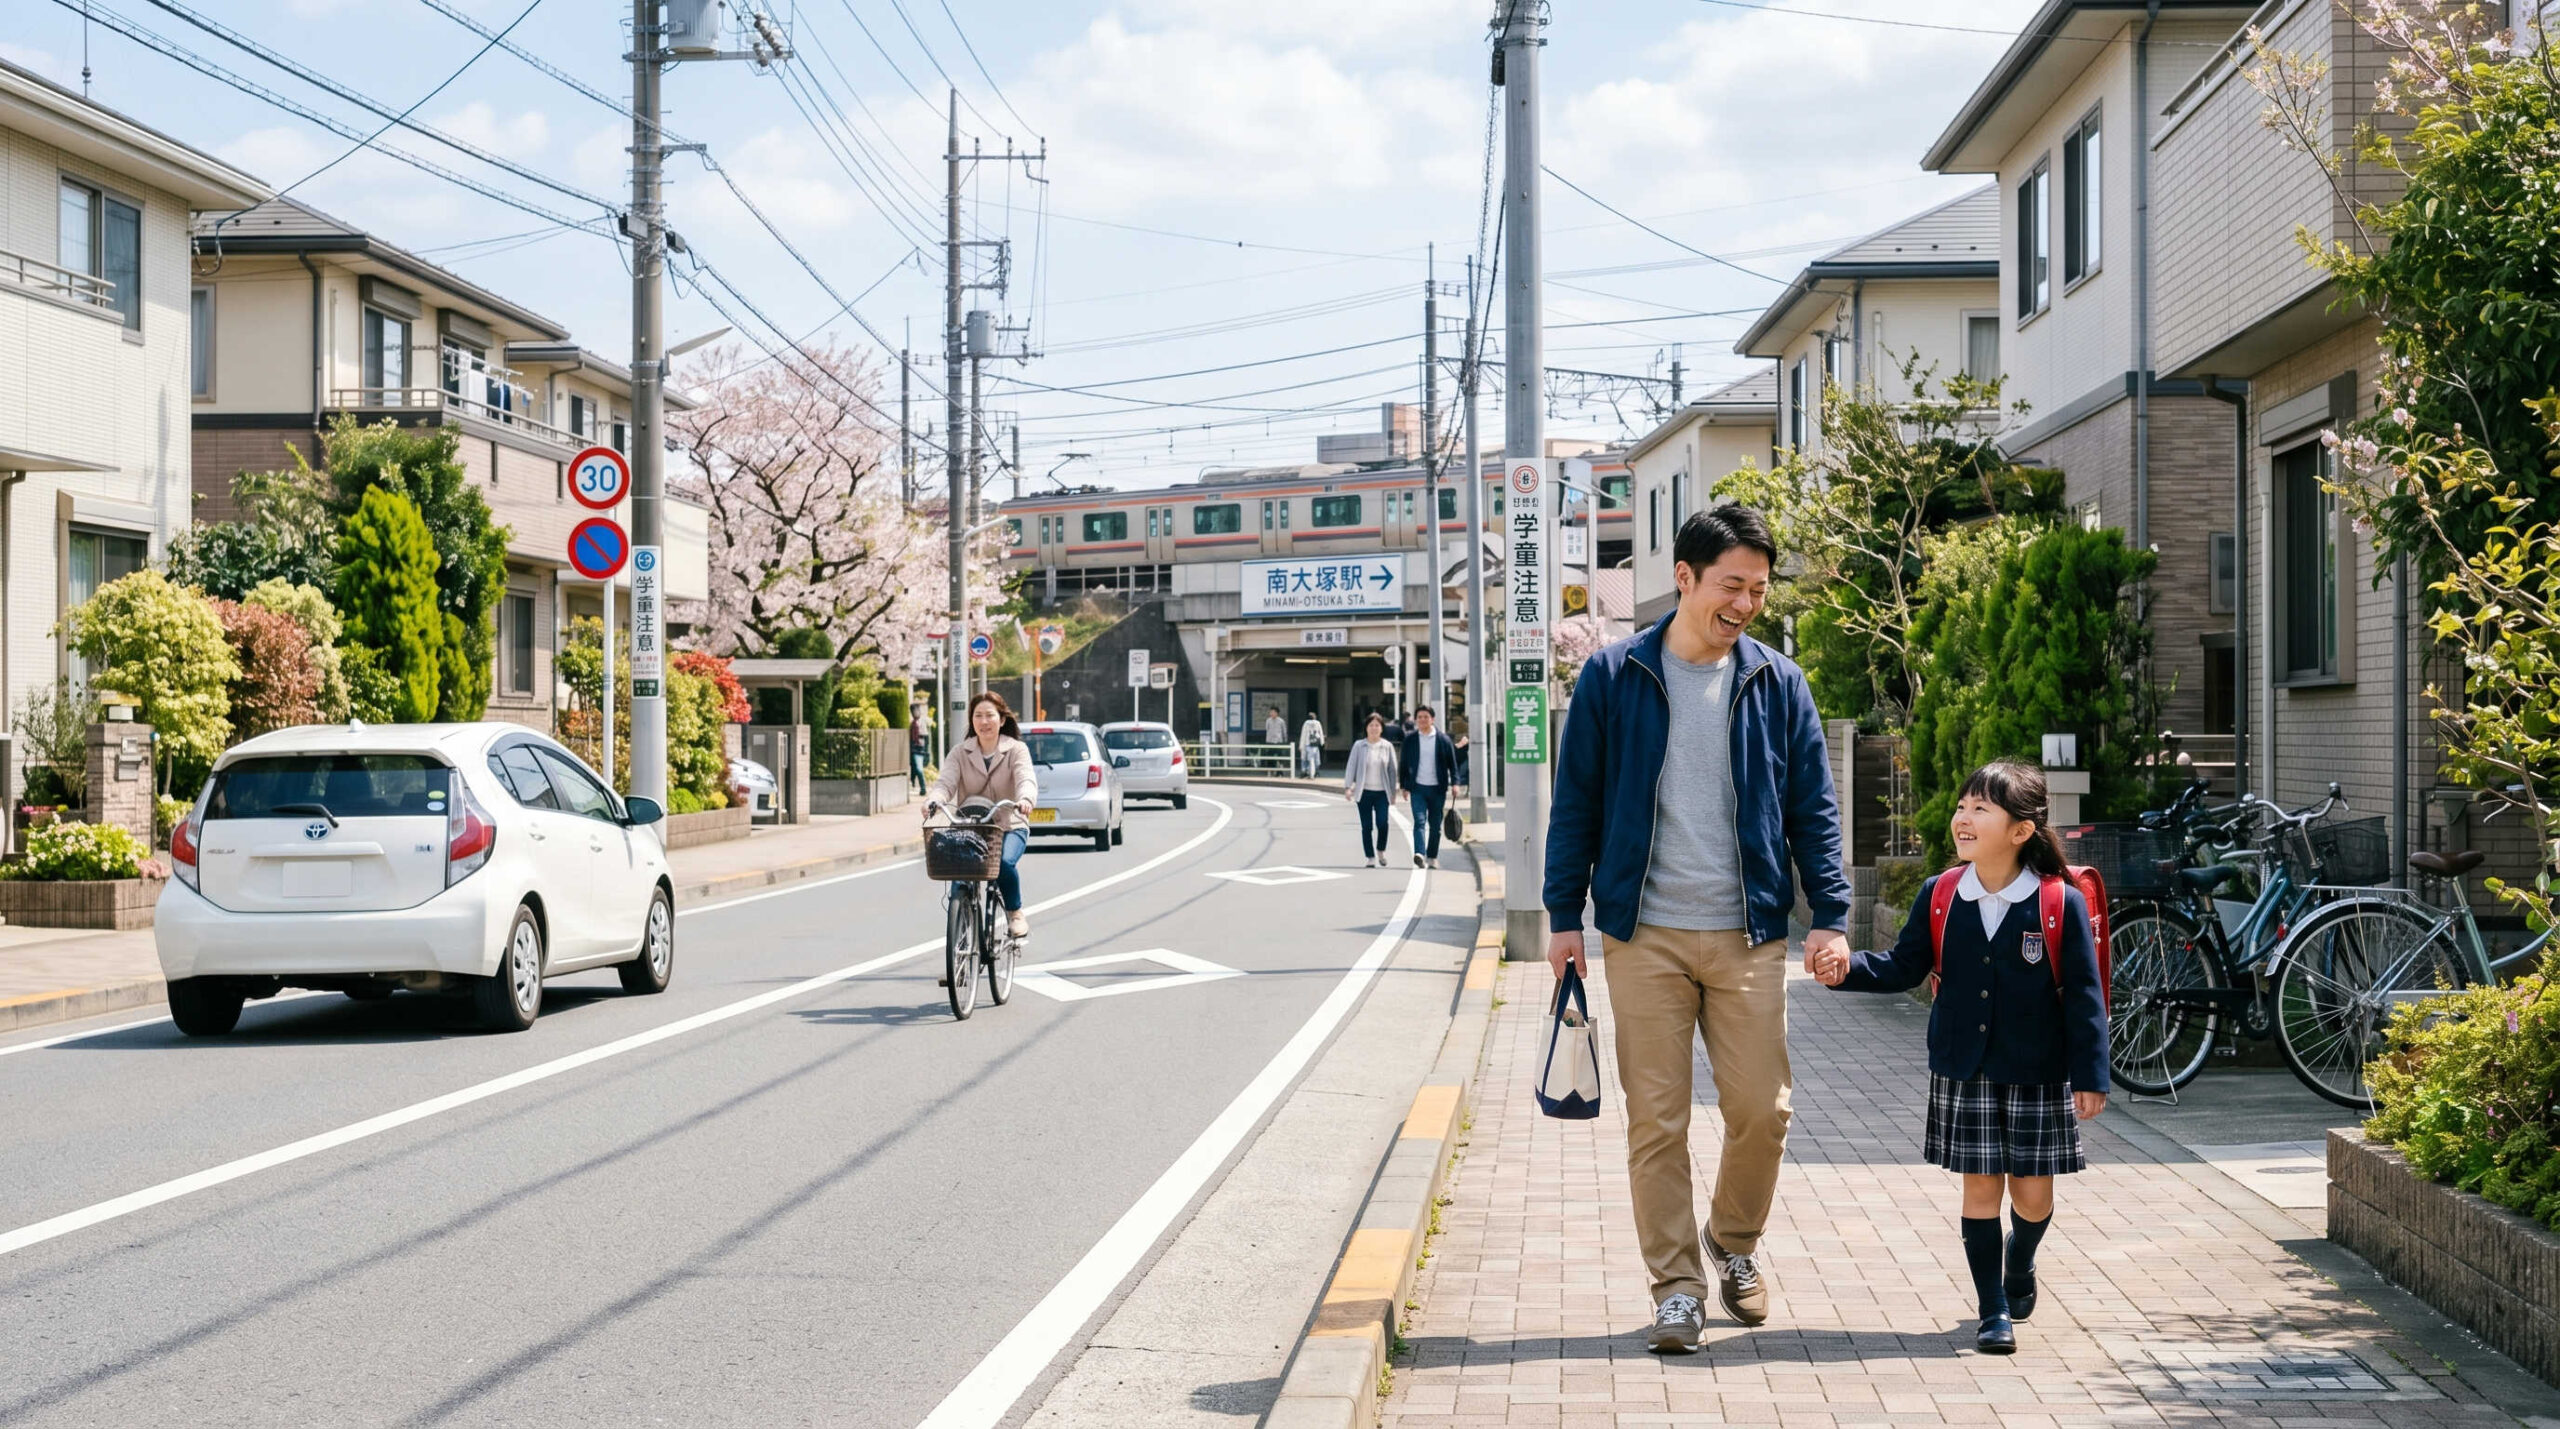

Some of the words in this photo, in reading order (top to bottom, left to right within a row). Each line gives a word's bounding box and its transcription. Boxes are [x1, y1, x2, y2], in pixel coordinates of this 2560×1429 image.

[581, 465, 616, 492] 30
[1267, 565, 1363, 594] 南大塚駅
[1514, 513, 1539, 623] 学童注意
[1263, 595, 1343, 608] MINAMI-OTSUKA
[1347, 594, 1366, 606] STA
[1512, 696, 1539, 751] 学童
